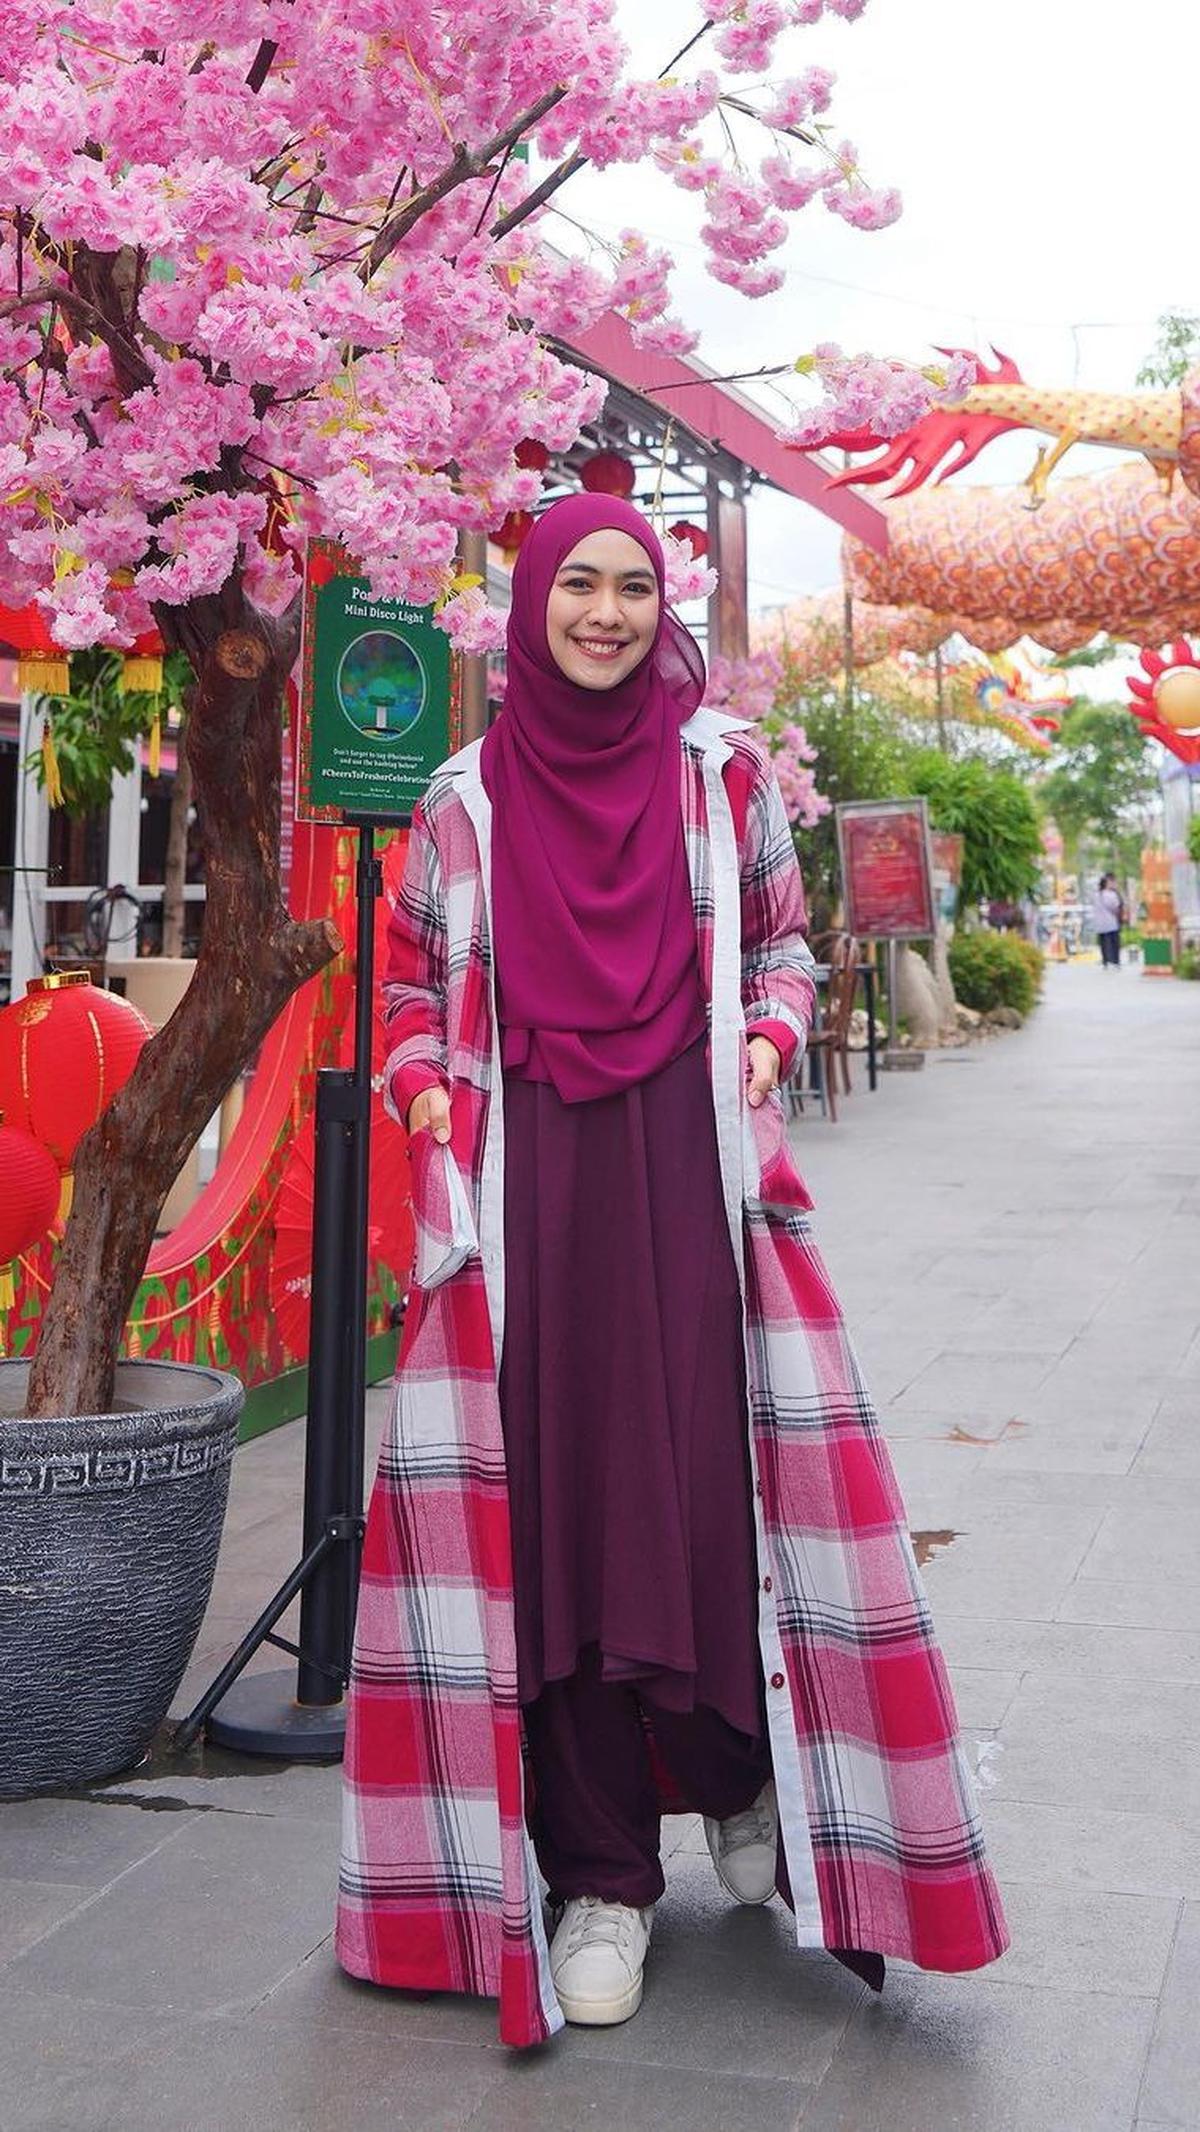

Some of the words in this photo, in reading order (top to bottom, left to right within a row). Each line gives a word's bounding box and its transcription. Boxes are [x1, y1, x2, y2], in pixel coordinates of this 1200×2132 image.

[344, 604, 368, 617] Mini
[370, 607, 397, 620] Disco
[398, 611, 424, 624] Light
